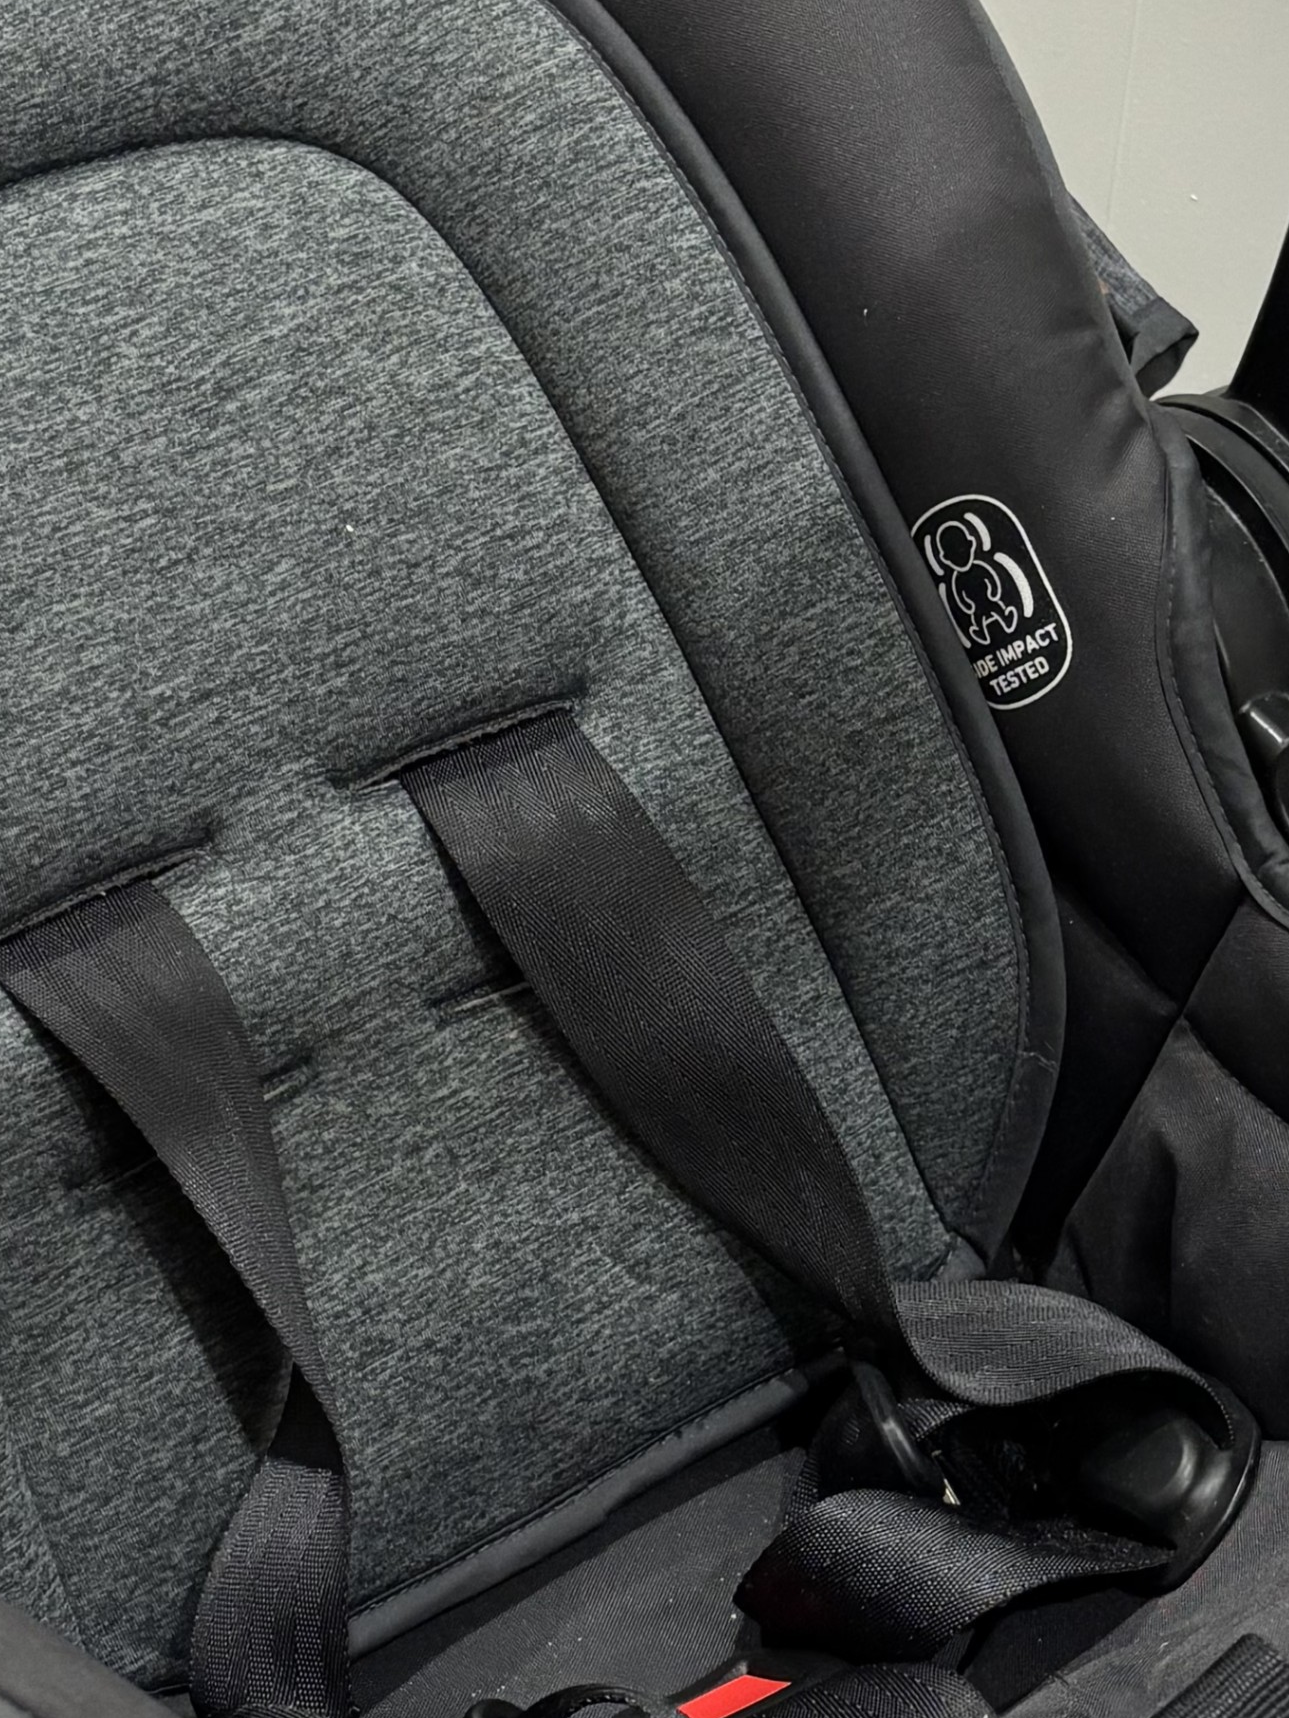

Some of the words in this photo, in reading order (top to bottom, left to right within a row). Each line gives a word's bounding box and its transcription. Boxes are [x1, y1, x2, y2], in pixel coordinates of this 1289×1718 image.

[972, 654, 998, 678] IDE
[995, 622, 1059, 667] IMPACT
[989, 656, 1050, 696] TESTED
